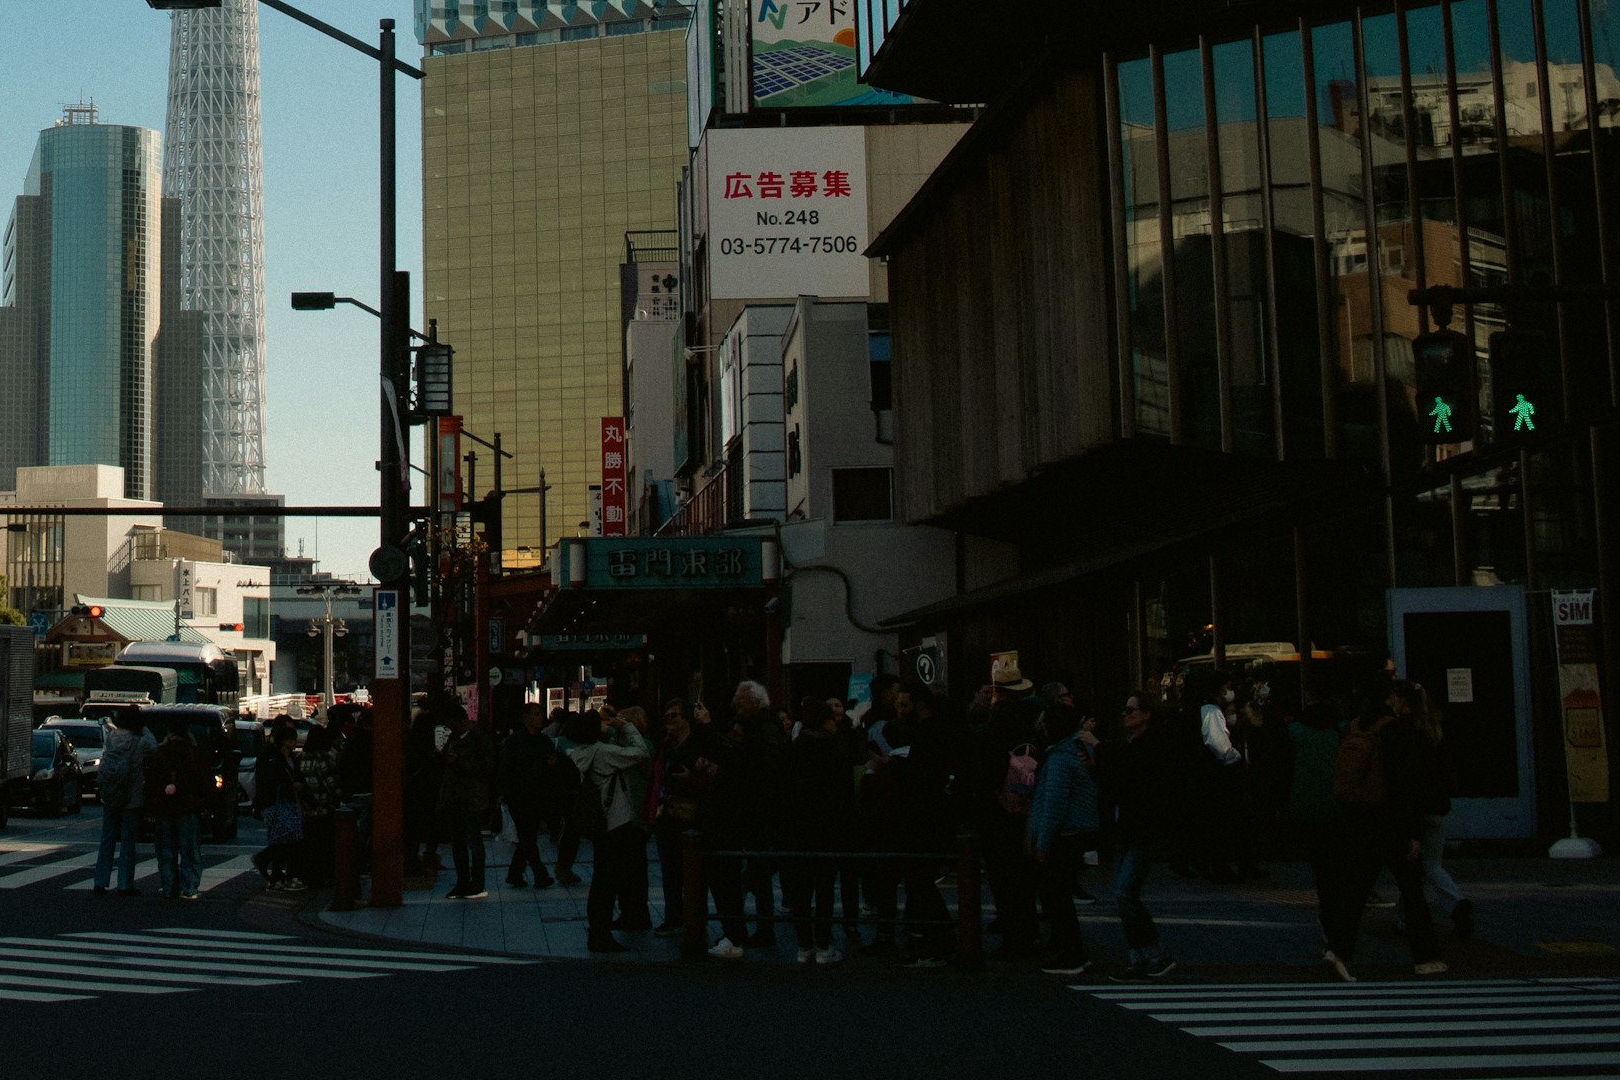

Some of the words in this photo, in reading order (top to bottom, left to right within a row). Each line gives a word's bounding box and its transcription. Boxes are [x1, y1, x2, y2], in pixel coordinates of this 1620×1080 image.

[723, 170, 852, 199] 広告募集
[720, 235, 858, 255] 03-5774-7506
[603, 424, 623, 536] 丸勝不動
[608, 548, 743, 577] 雷門東部
[182, 568, 191, 606] 水上バス
[1558, 603, 1590, 621] SIM
